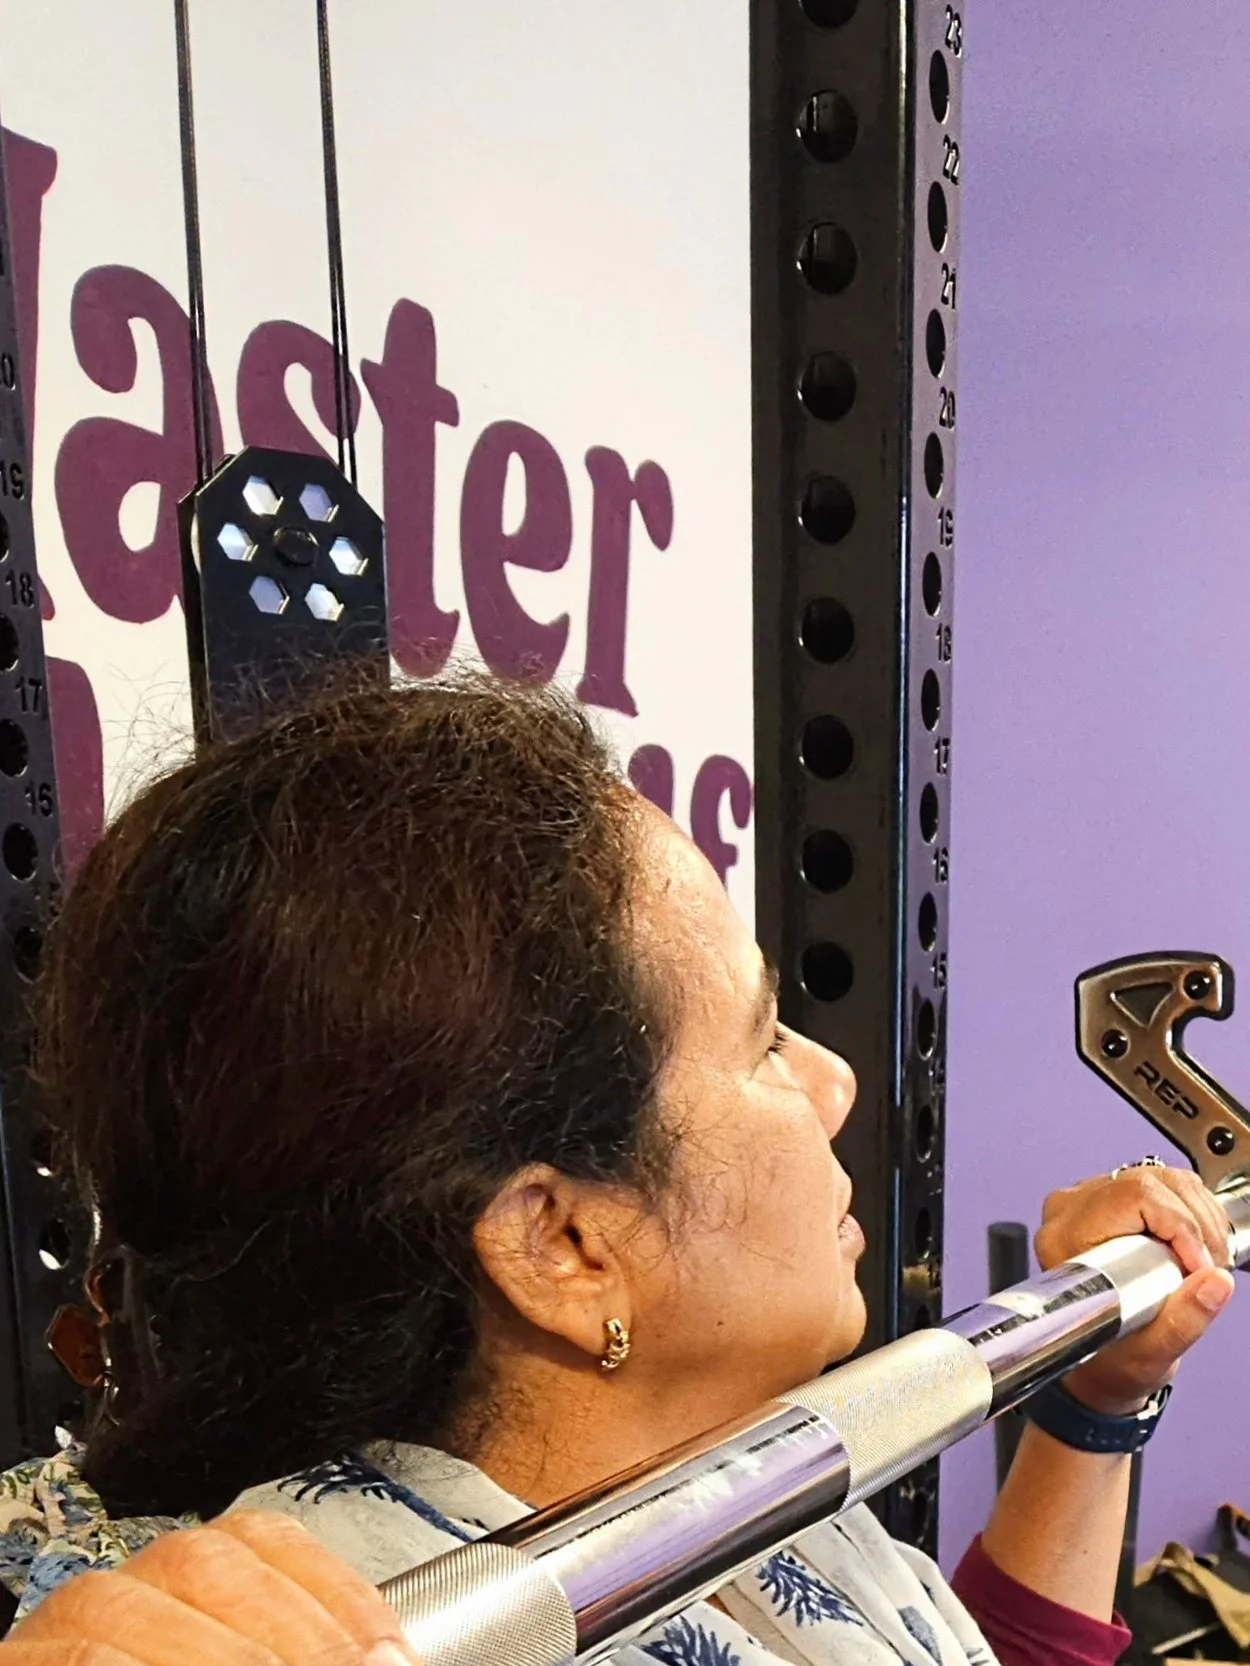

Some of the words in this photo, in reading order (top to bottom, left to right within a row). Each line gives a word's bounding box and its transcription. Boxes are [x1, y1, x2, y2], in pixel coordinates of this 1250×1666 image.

[0, 352, 15, 391] 0
[0, 125, 674, 718] aster
[6, 569, 35, 608] 18
[15, 676, 42, 713] 17
[1133, 1060, 1199, 1121] REP
